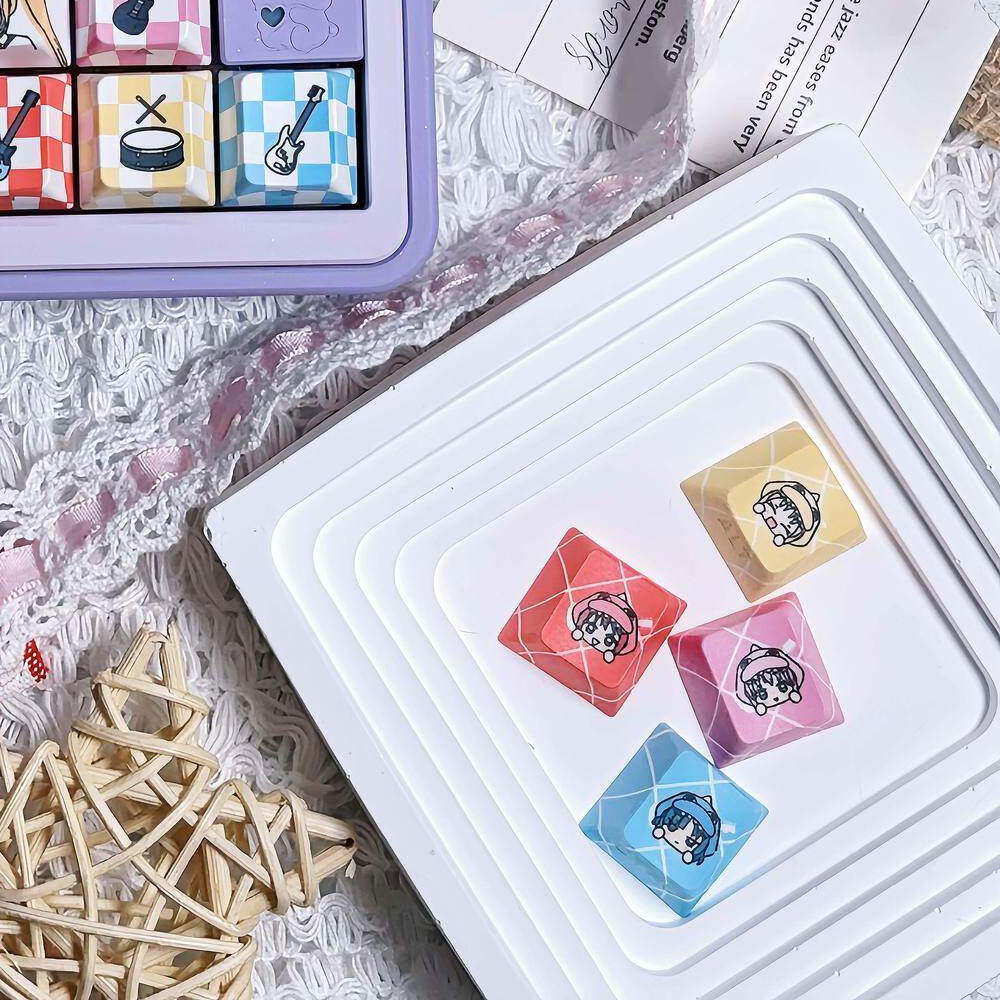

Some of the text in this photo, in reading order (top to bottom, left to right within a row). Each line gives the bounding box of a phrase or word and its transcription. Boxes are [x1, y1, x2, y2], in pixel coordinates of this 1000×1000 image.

[830, 4, 859, 41] jazz
[779, 36, 804, 66] has
[805, 44, 836, 91] eases
[755, 68, 788, 111] been
[782, 94, 814, 135] from
[732, 117, 761, 154] very
